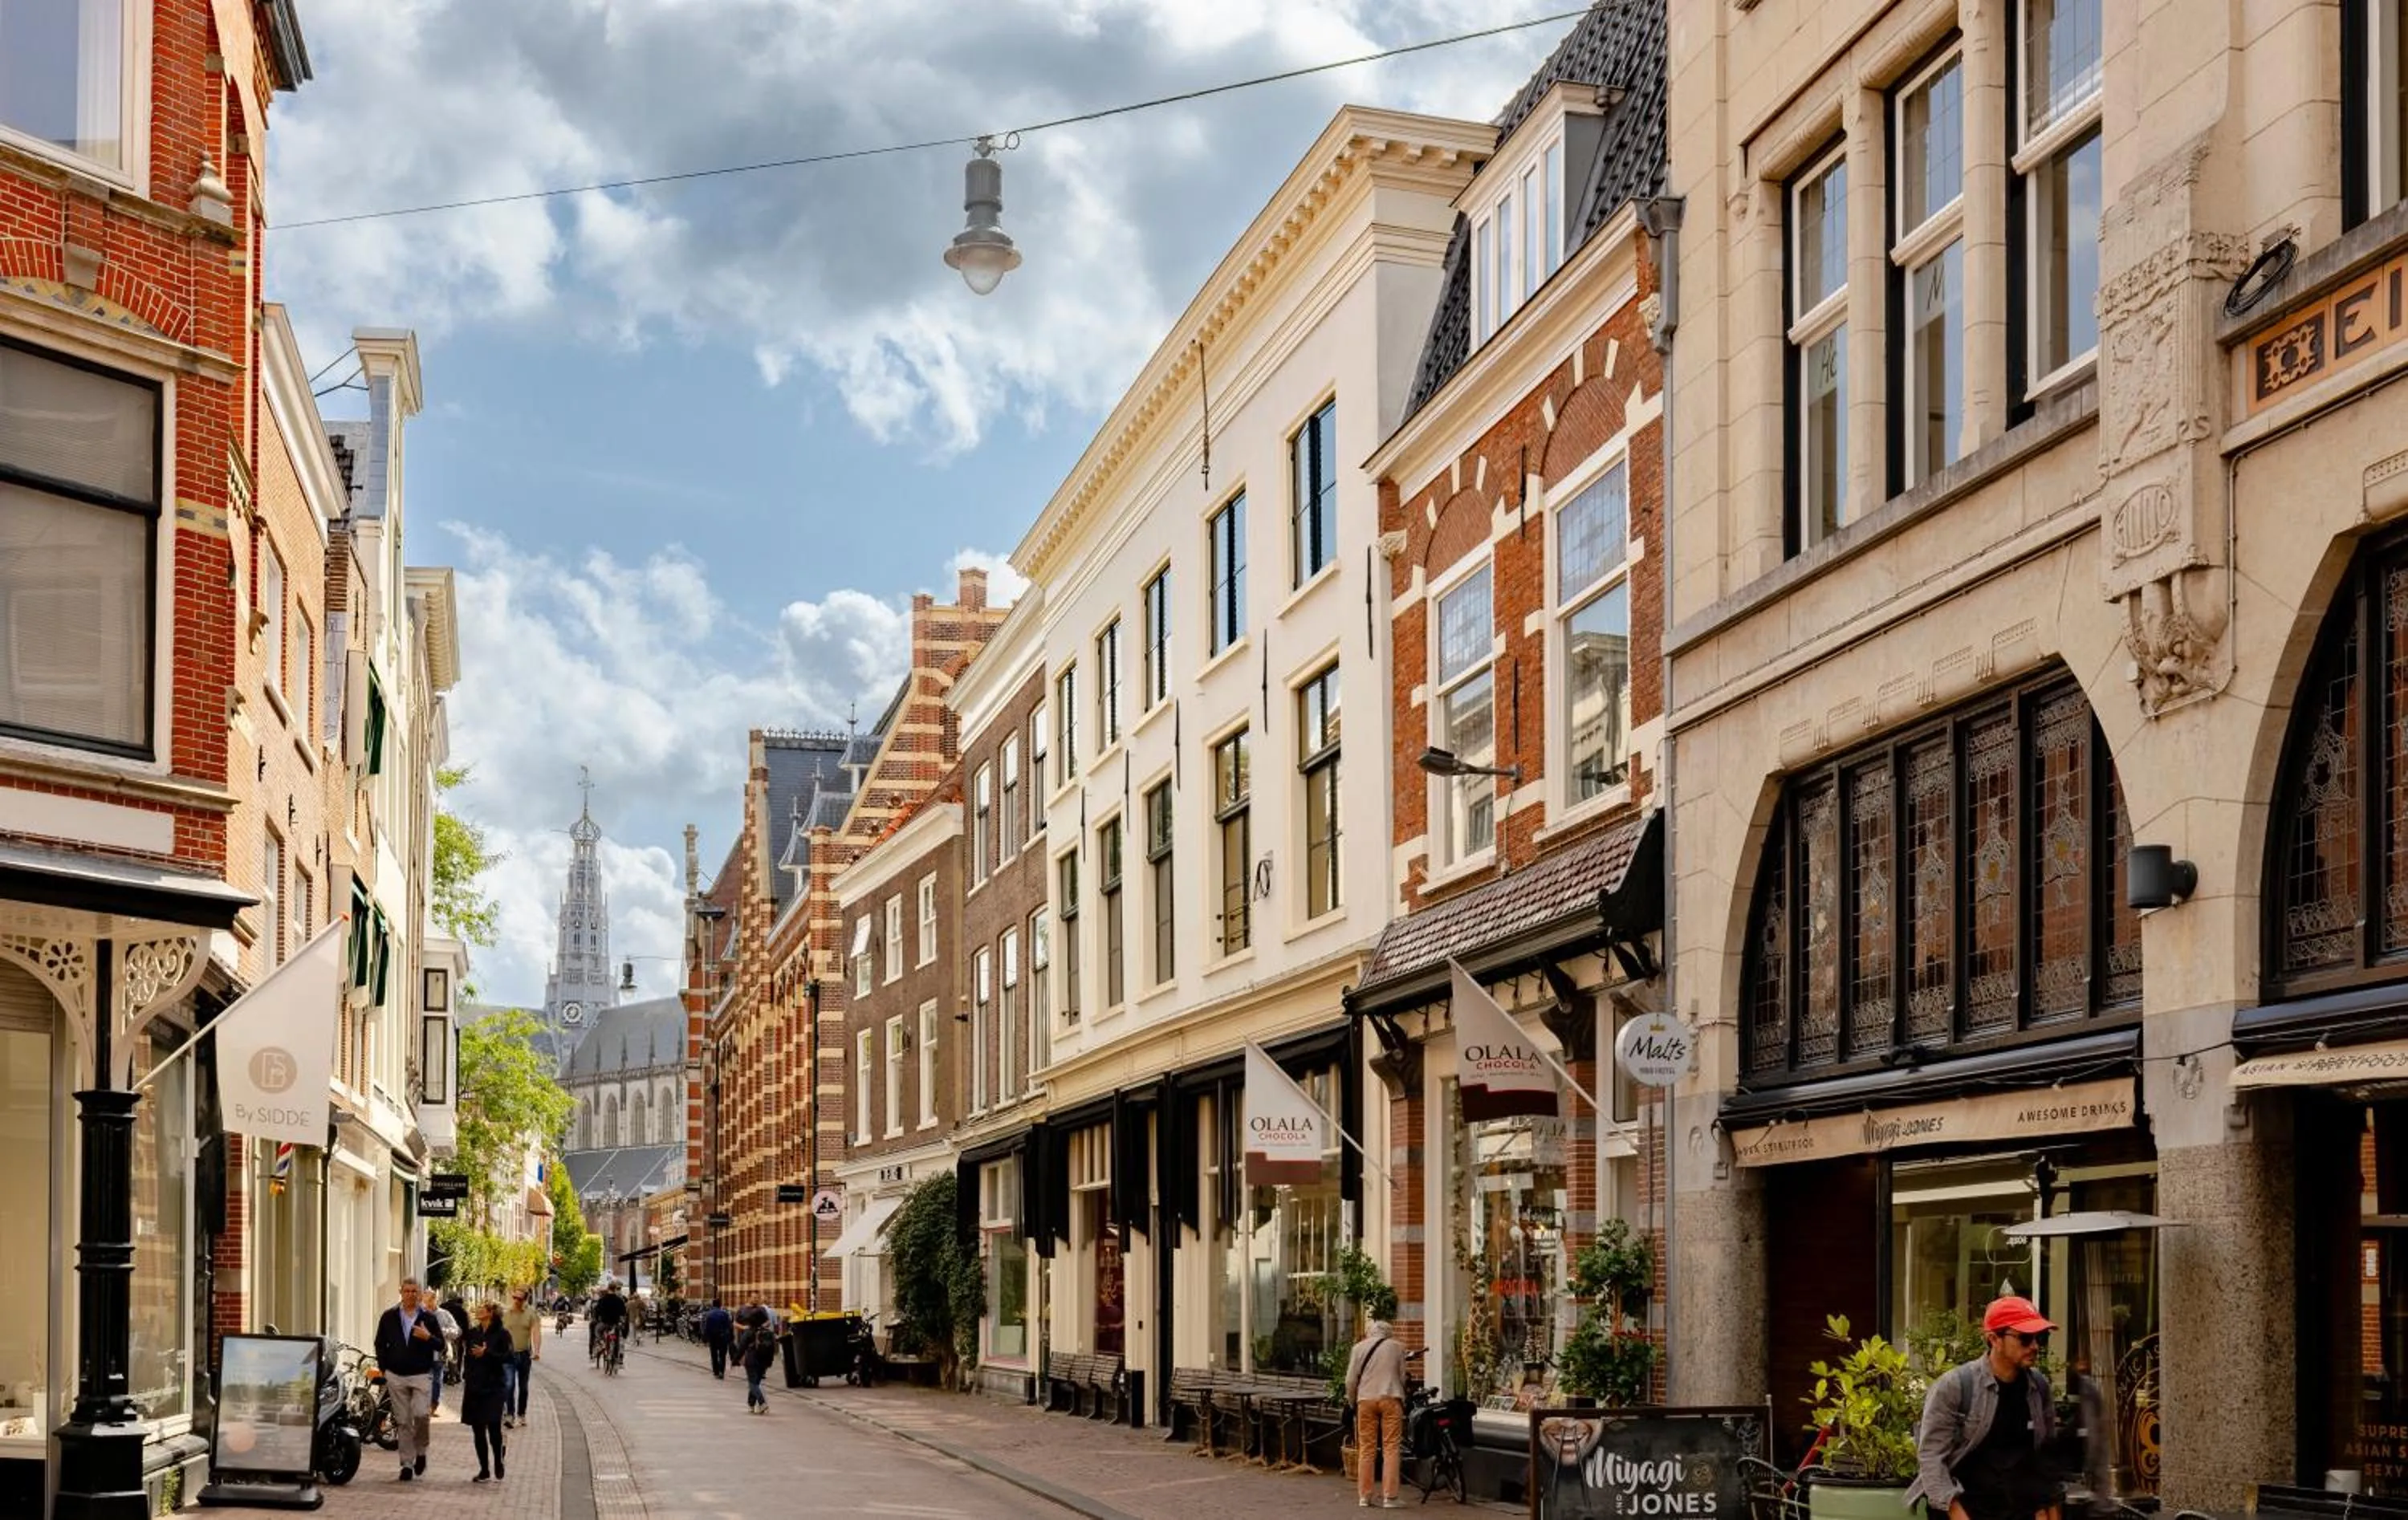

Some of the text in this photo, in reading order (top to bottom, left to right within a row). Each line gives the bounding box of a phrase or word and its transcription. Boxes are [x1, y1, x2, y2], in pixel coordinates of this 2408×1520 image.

[1465, 1044, 1542, 1065] OLALA
[1629, 1035, 1686, 1061] Malts
[1476, 1059, 1536, 1071] CHOCOLA
[235, 1103, 311, 1127] By SIDDE
[2017, 1101, 2127, 1124] AWESOME DRINKS
[1251, 1116, 1312, 1132] OLALA
[1259, 1132, 1307, 1140] CHOCOLA
[2345, 1442, 2391, 1457] ASIAN
[1585, 1445, 1687, 1494] Miyagi
[2364, 1463, 2403, 1477] SEXY
[1616, 1495, 1625, 1514] AND
[1626, 1493, 1717, 1515] JONES
